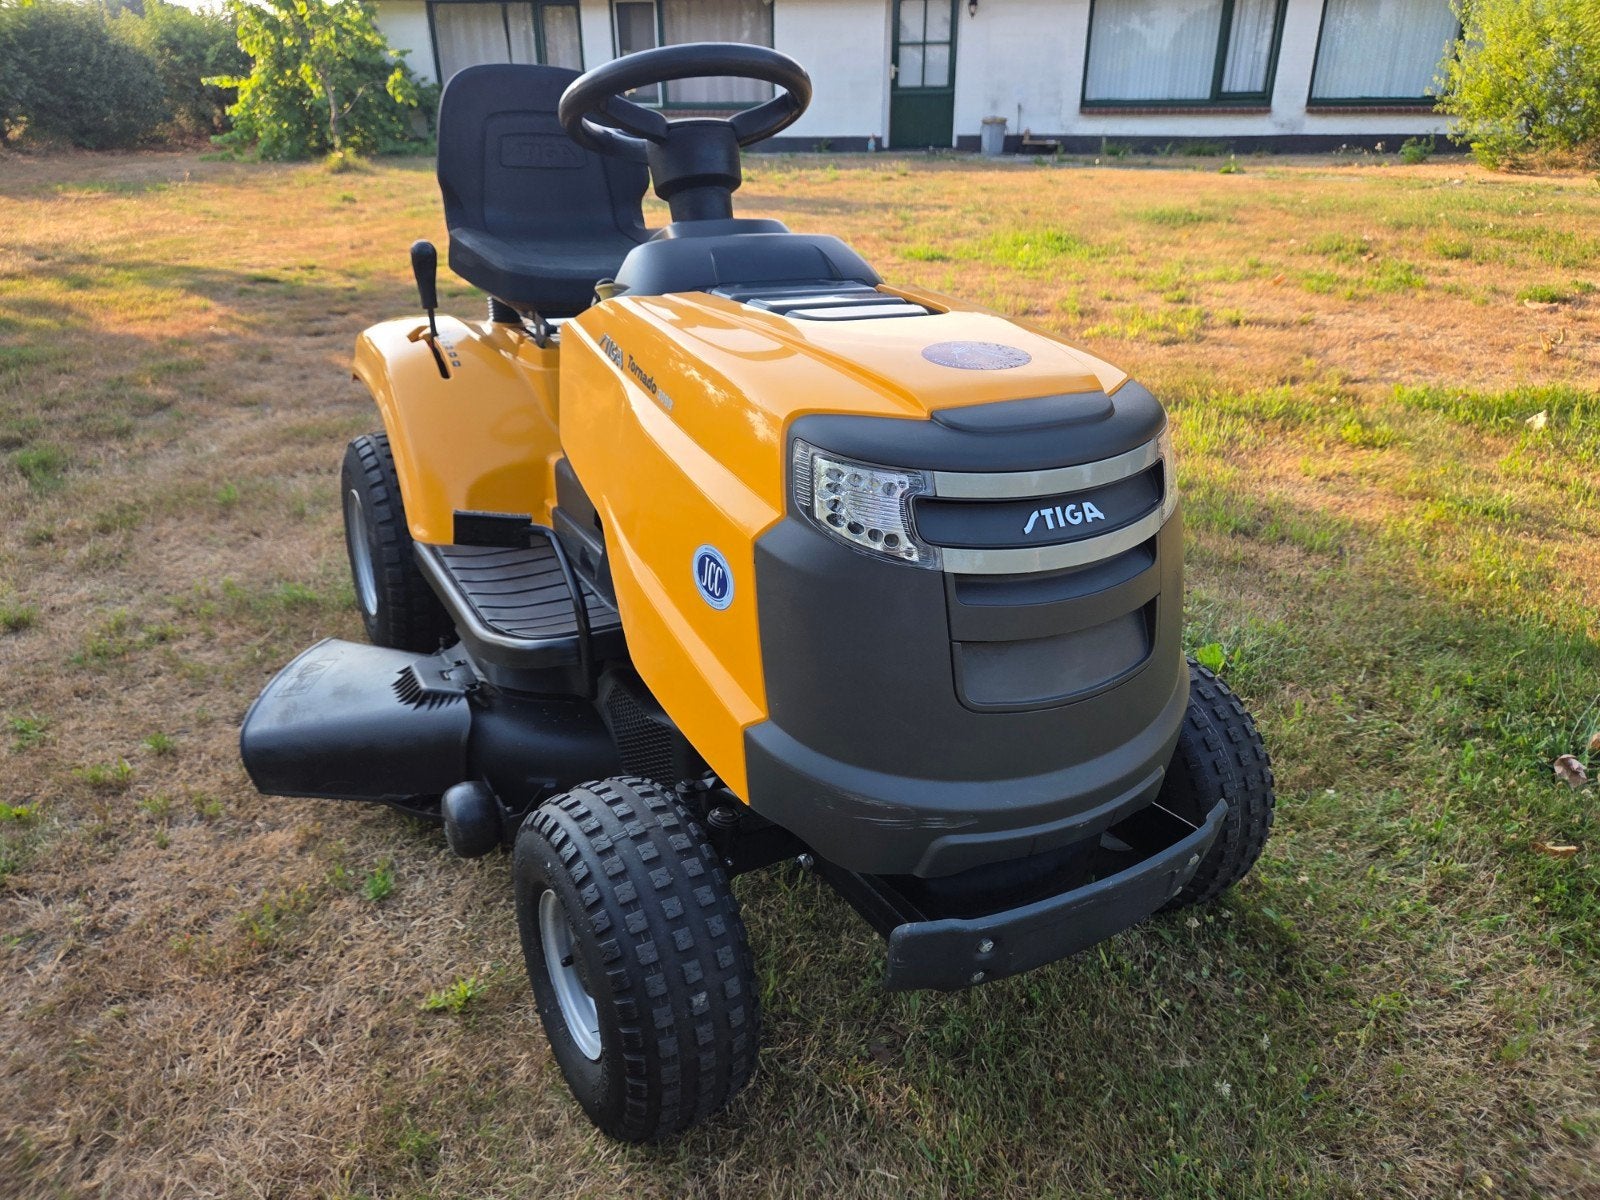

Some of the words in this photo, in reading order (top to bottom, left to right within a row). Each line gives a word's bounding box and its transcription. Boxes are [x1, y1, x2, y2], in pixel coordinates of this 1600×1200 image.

[598, 333, 624, 371] STIGA
[627, 353, 658, 395] Tornado
[1023, 501, 1106, 535] STIGA
[701, 556, 723, 597] JCC
